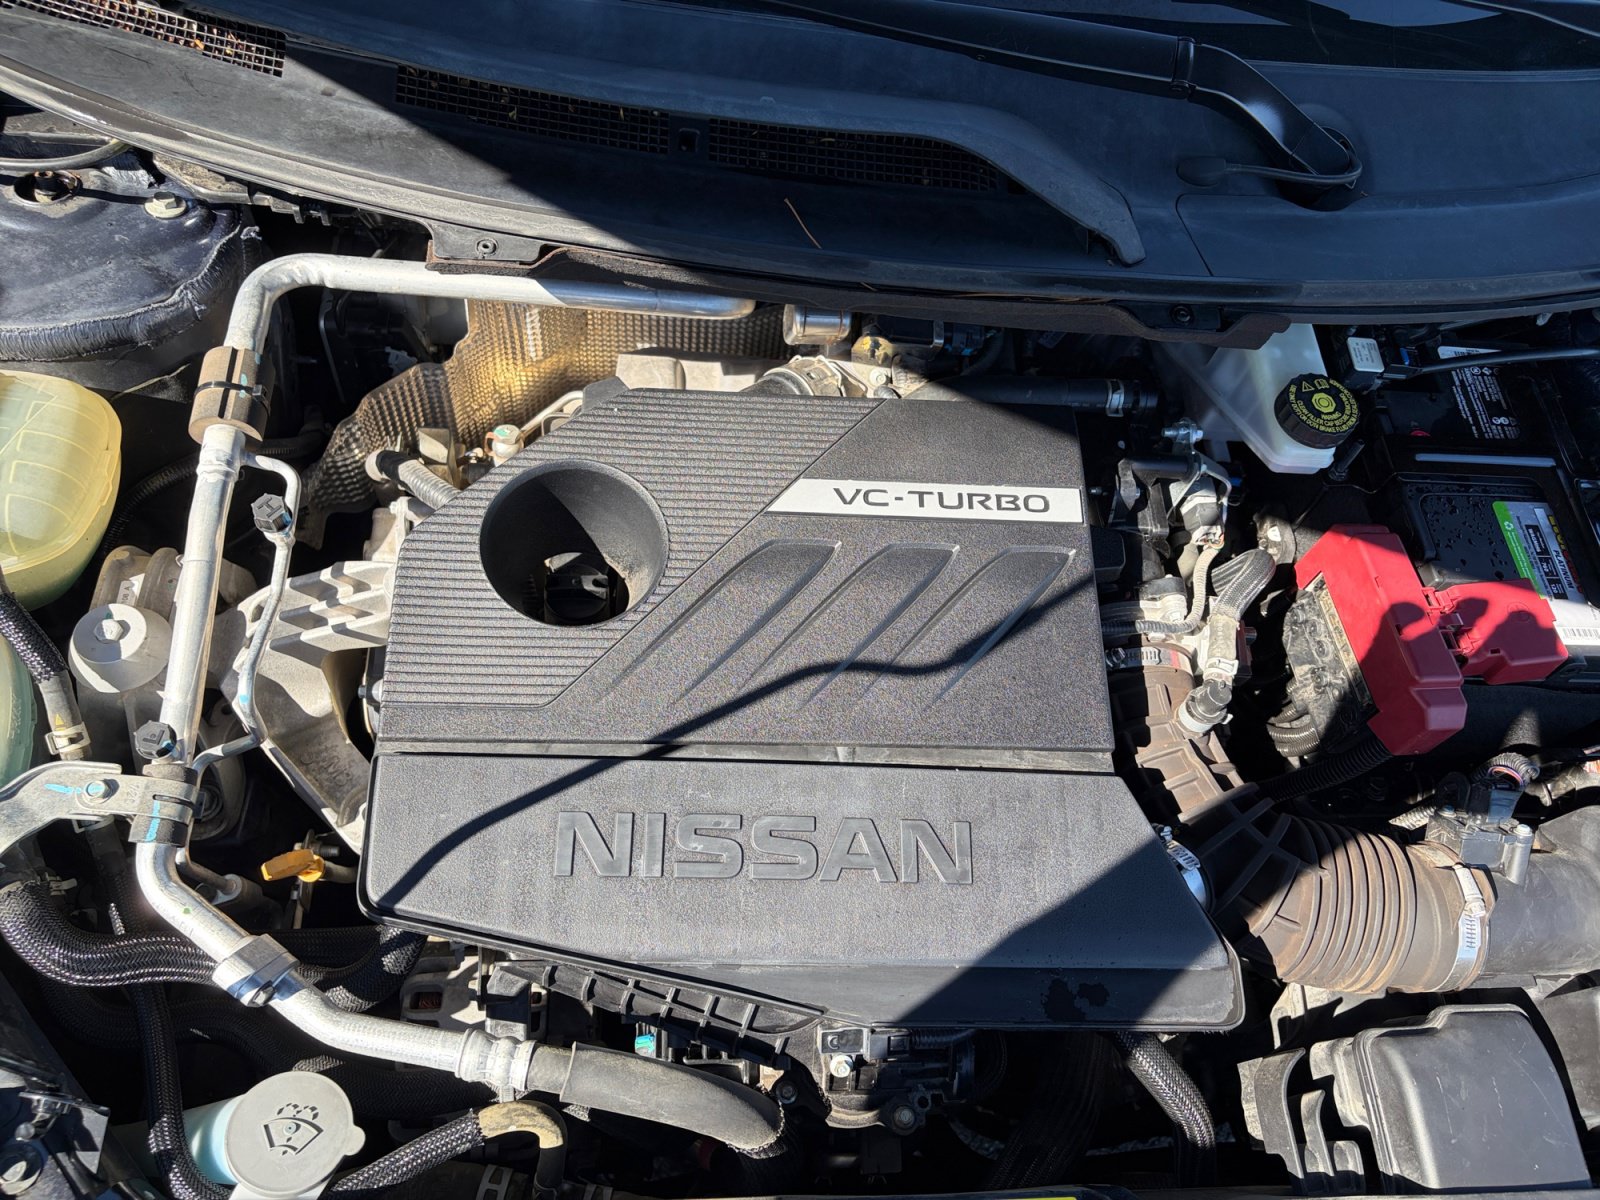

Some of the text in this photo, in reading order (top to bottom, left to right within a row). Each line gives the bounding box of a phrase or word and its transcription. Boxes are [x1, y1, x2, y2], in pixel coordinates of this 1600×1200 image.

[1297, 400, 1309, 415] CLEAN
[1307, 412, 1323, 425] FILLER
[1299, 413, 1308, 421] OR
[1319, 425, 1335, 433] BRAKE
[833, 487, 1050, 513] VC-TURBO
[1553, 550, 1574, 589] PLATINUM
[555, 811, 973, 884] NISSAN
